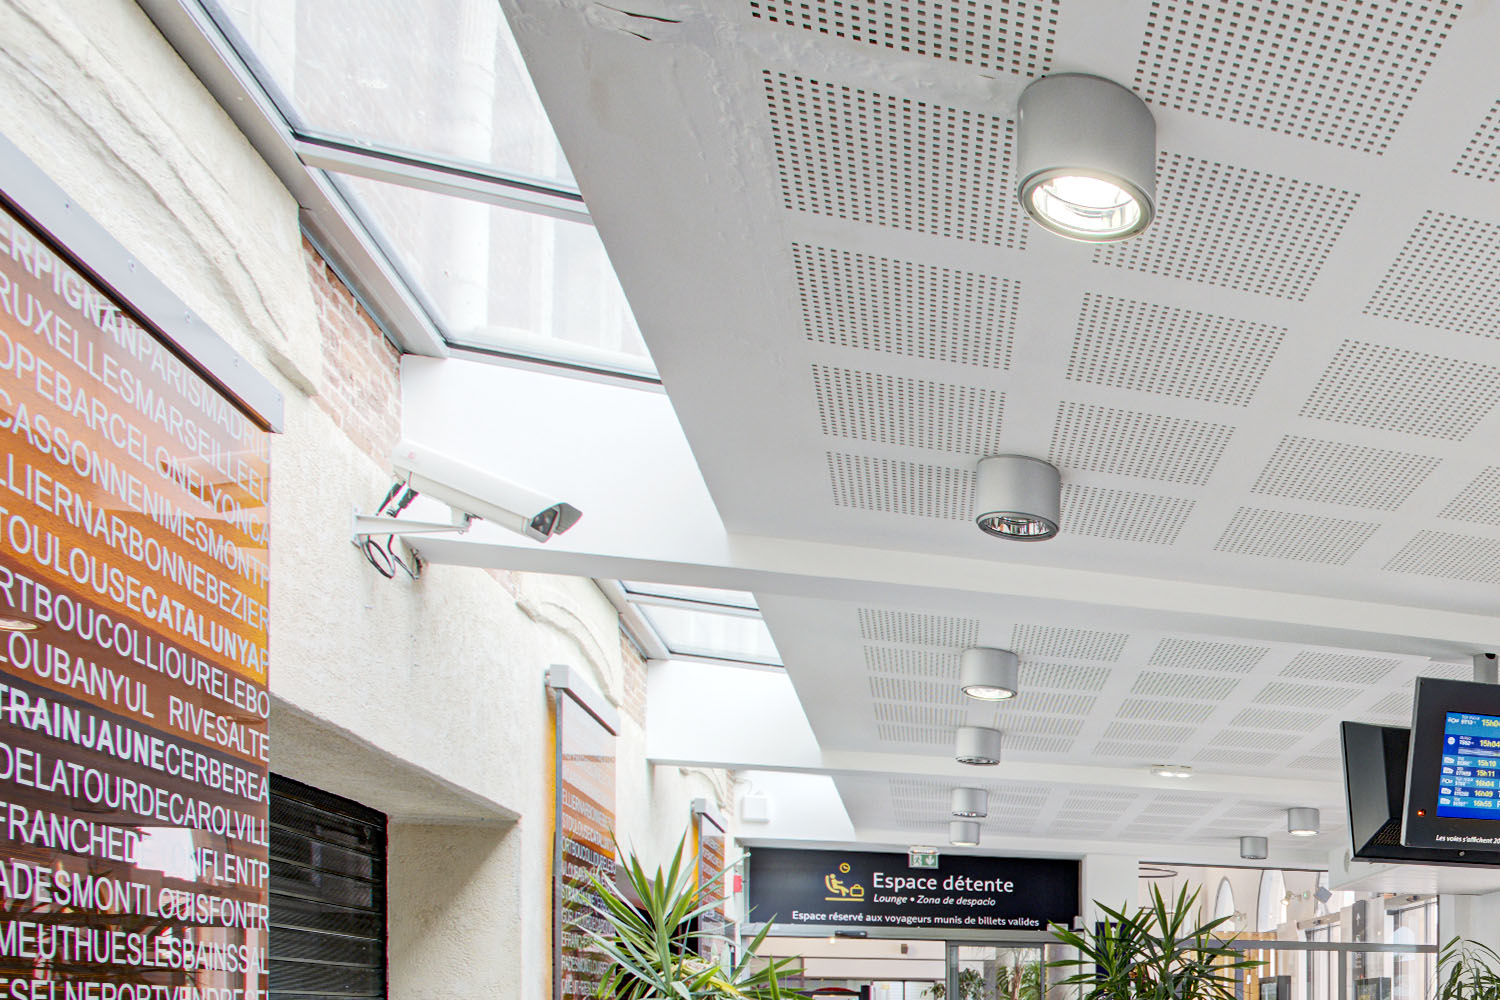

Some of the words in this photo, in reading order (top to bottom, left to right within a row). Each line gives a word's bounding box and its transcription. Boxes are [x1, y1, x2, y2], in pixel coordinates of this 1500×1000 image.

[0, 624, 153, 719] OUBANYUL
[169, 695, 269, 764] RIVESALTE
[1480, 739, 1500, 748] 15h04
[1435, 834, 1446, 842] Les
[873, 872, 937, 893] Espace
[943, 875, 1014, 893] détente
[873, 894, 908, 905] Lounge
[917, 895, 942, 905] Zona
[943, 896, 954, 905] de
[956, 897, 996, 907] despacio
[792, 911, 827, 922] Espace
[828, 911, 864, 921] réservé
[866, 914, 882, 922] aux
[884, 914, 932, 925] voyageurs
[934, 915, 963, 924] munis
[965, 916, 976, 925] de
[978, 916, 1006, 926] billets
[1008, 917, 1040, 927] valides
